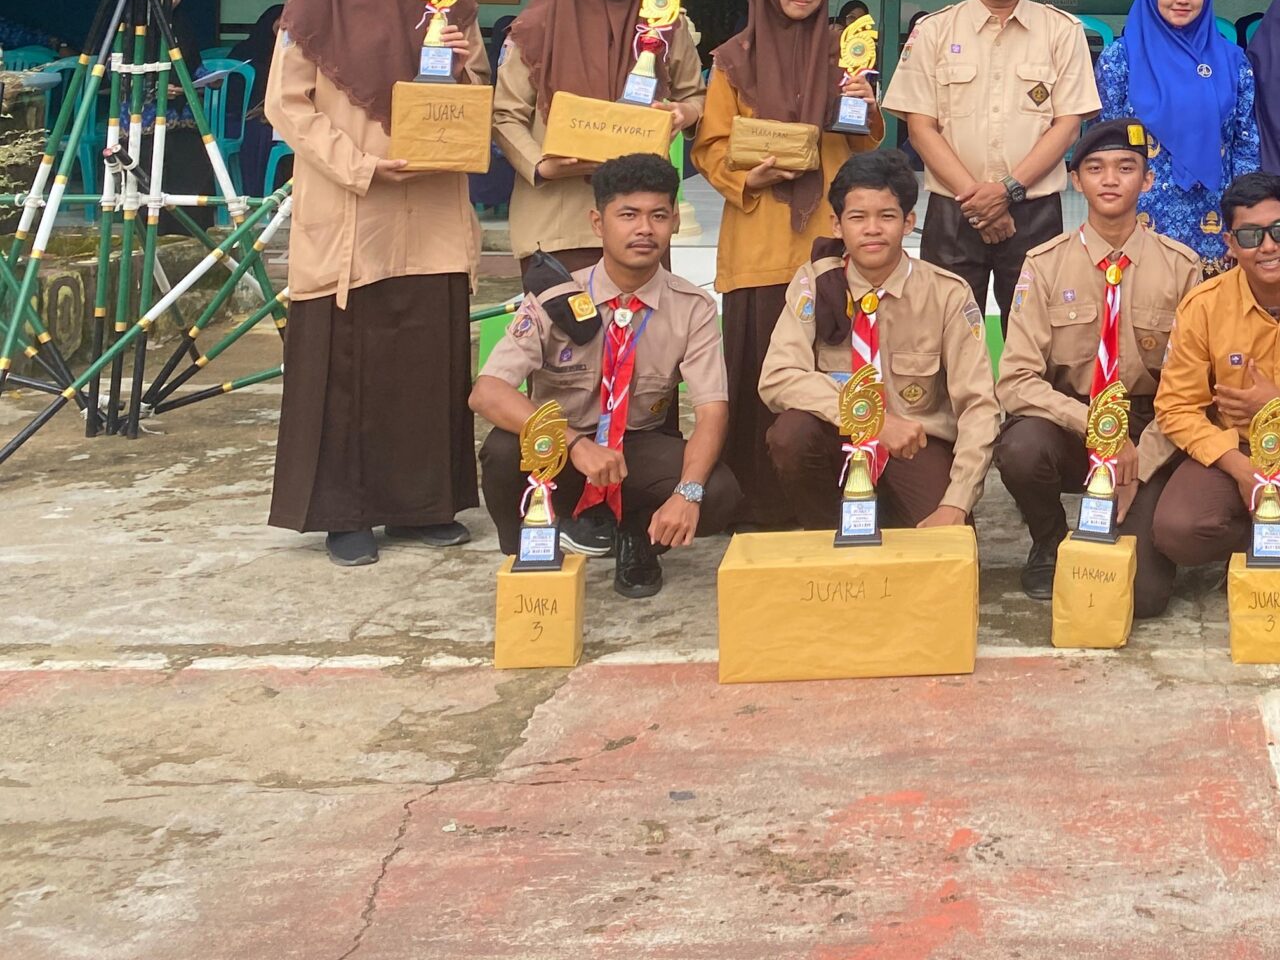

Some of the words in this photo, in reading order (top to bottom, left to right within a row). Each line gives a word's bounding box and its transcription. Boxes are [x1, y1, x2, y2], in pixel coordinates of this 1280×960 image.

[422, 102, 465, 121] JUARA
[436, 127, 447, 144] 2
[569, 117, 607, 130] STAND
[611, 123, 657, 138] FAVORIT
[1072, 566, 1117, 583] HARAPAN
[800, 580, 866, 603] JUARA
[879, 575, 892, 599] 1
[513, 593, 558, 617] JUARA
[1087, 592, 1095, 608] 1
[530, 620, 544, 642] 3
[1264, 614, 1276, 632] 3
